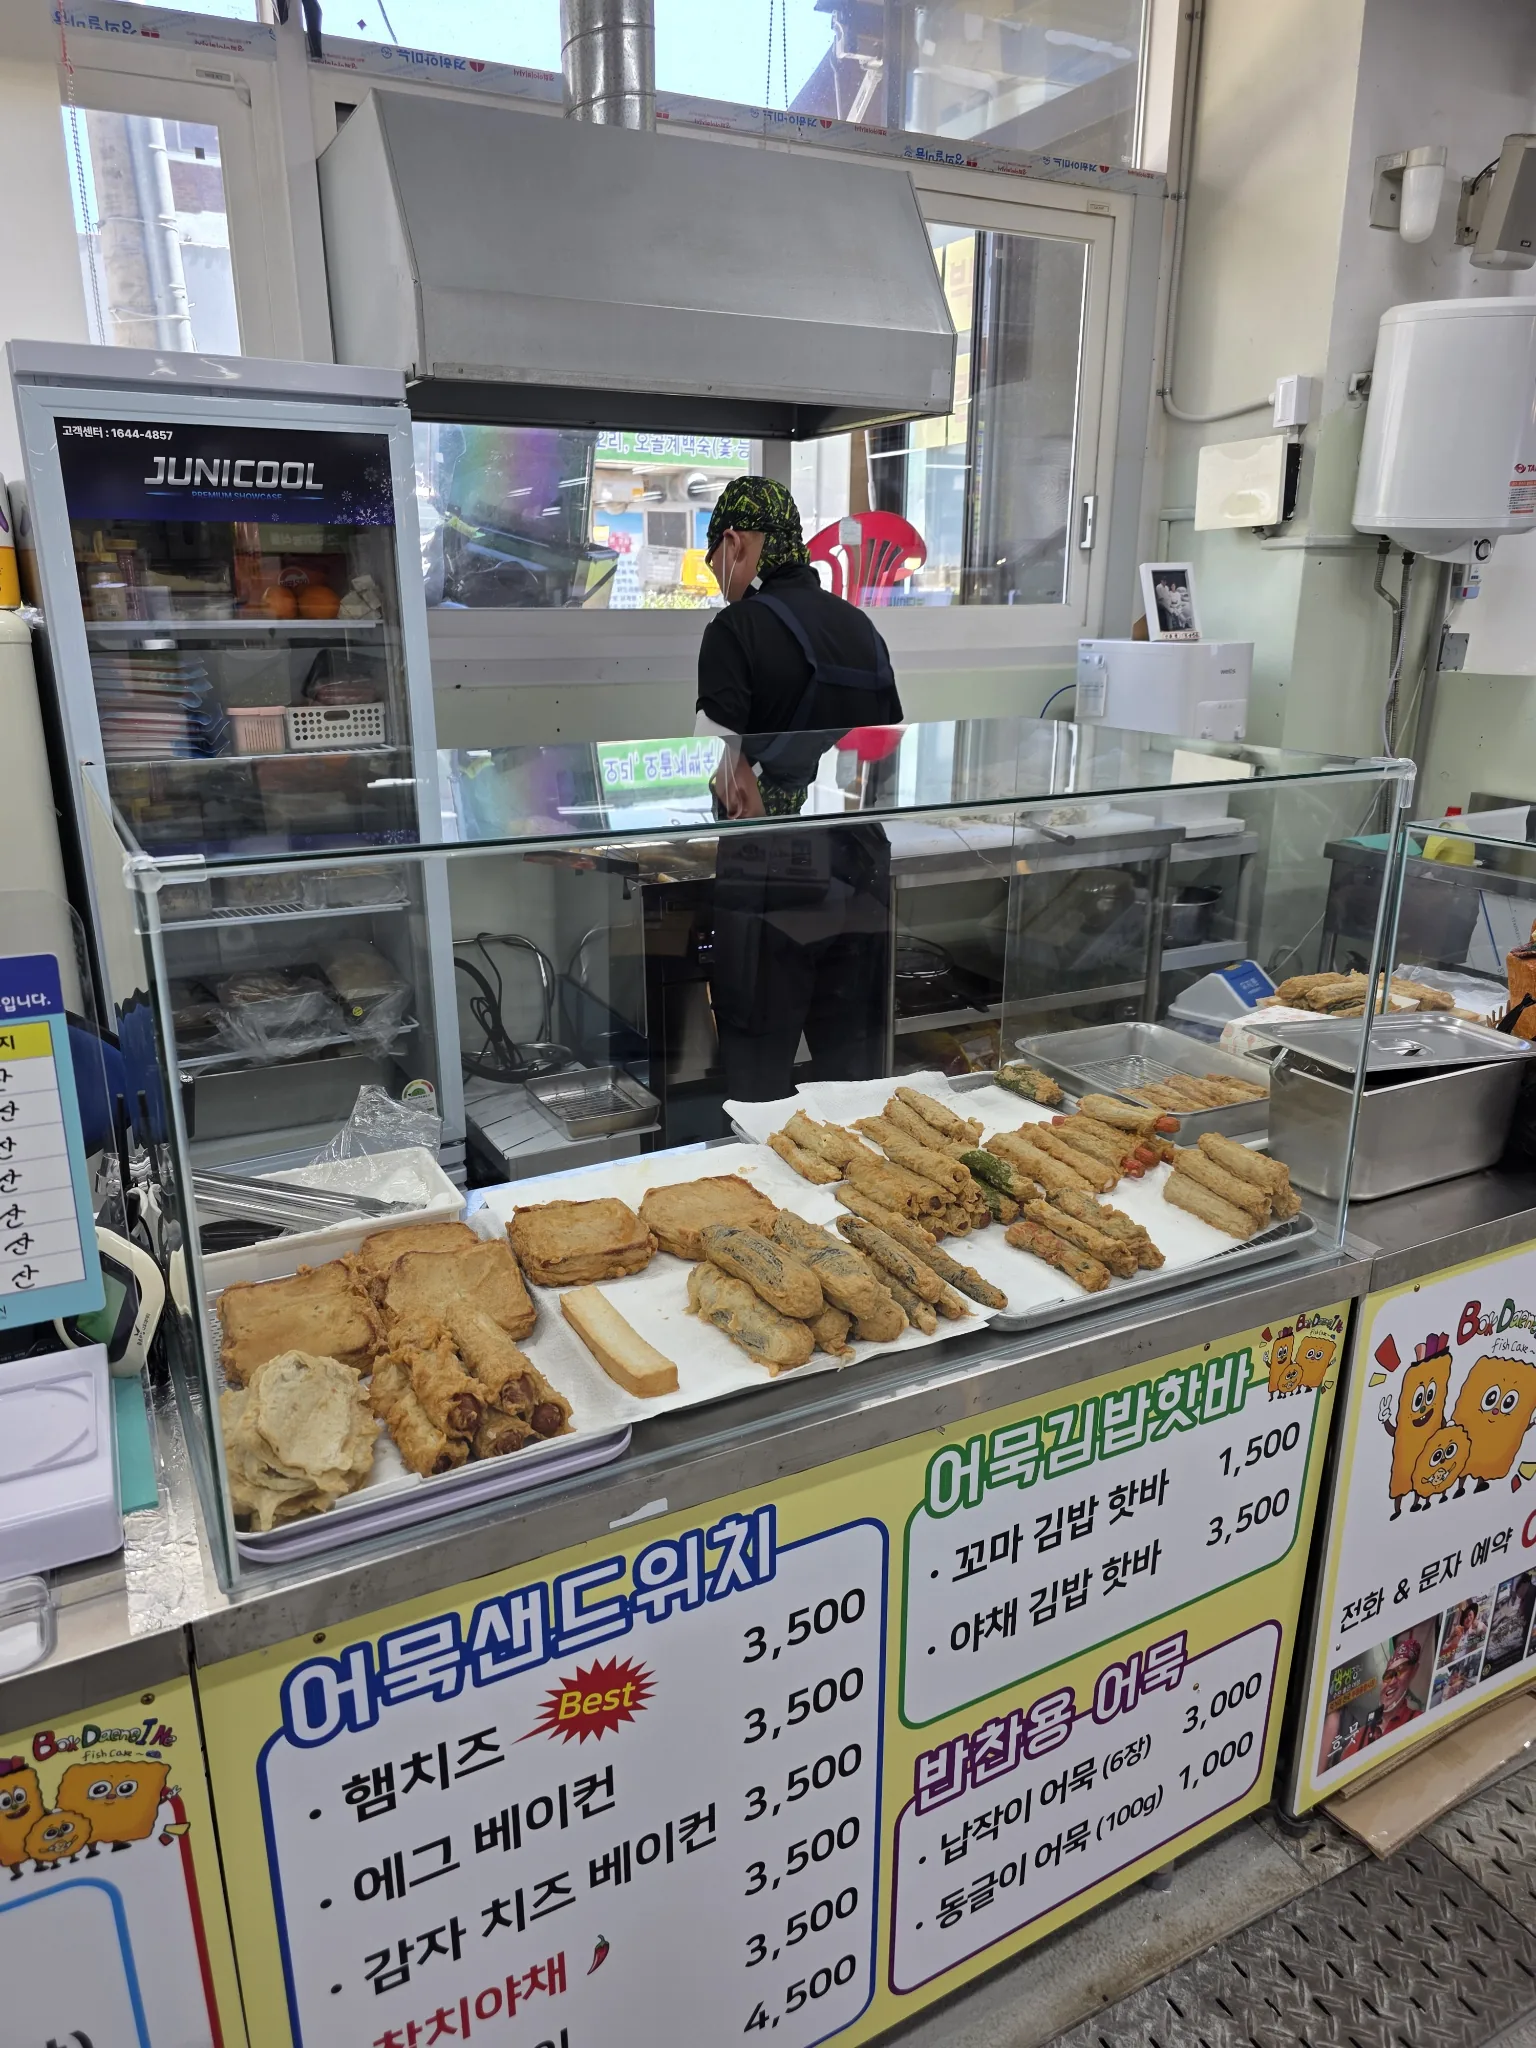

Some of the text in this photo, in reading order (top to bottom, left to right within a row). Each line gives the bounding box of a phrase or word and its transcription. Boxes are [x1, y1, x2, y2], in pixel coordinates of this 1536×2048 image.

[62, 425, 103, 439] 고객센터
[111, 428, 173, 441] 1644-4857
[144, 456, 324, 490] JUNICOOL
[191, 490, 282, 501] PREMIUM SHOWCASE
[924, 1347, 1255, 1519] 어묵김밥핫바
[952, 1421, 1300, 1583] 꼬마 김밥 핫바 1,500
[281, 1504, 777, 1748] 어묵샌드위치
[950, 1487, 1290, 1653] 야채 김밥 핫바 3,500
[1340, 1587, 1384, 1633] 전화
[1393, 1578, 1410, 1604] &
[1419, 1550, 1462, 1593] 문자
[1470, 1527, 1514, 1568] 예약
[341, 1588, 866, 1822] 햄치즈 3,500
[559, 1680, 636, 1721] Best
[914, 1629, 1189, 1817] 반찬용 어묵
[941, 1789, 1031, 1866] 납작이
[1040, 1757, 1098, 1807] 어묵
[1102, 1734, 1153, 1781] (6장)
[1182, 1671, 1262, 1735] 3,000
[353, 1666, 865, 1903] 에그 베이컨 3,500
[745, 1816, 861, 1897] 3,500
[935, 1730, 1254, 1930] 동글이 어묵 (100g) 1,000
[363, 1742, 862, 1995] 감자 치즈 베이컨 3,500
[745, 1887, 859, 1968] 3,500
[745, 1954, 857, 2034] 4,500
